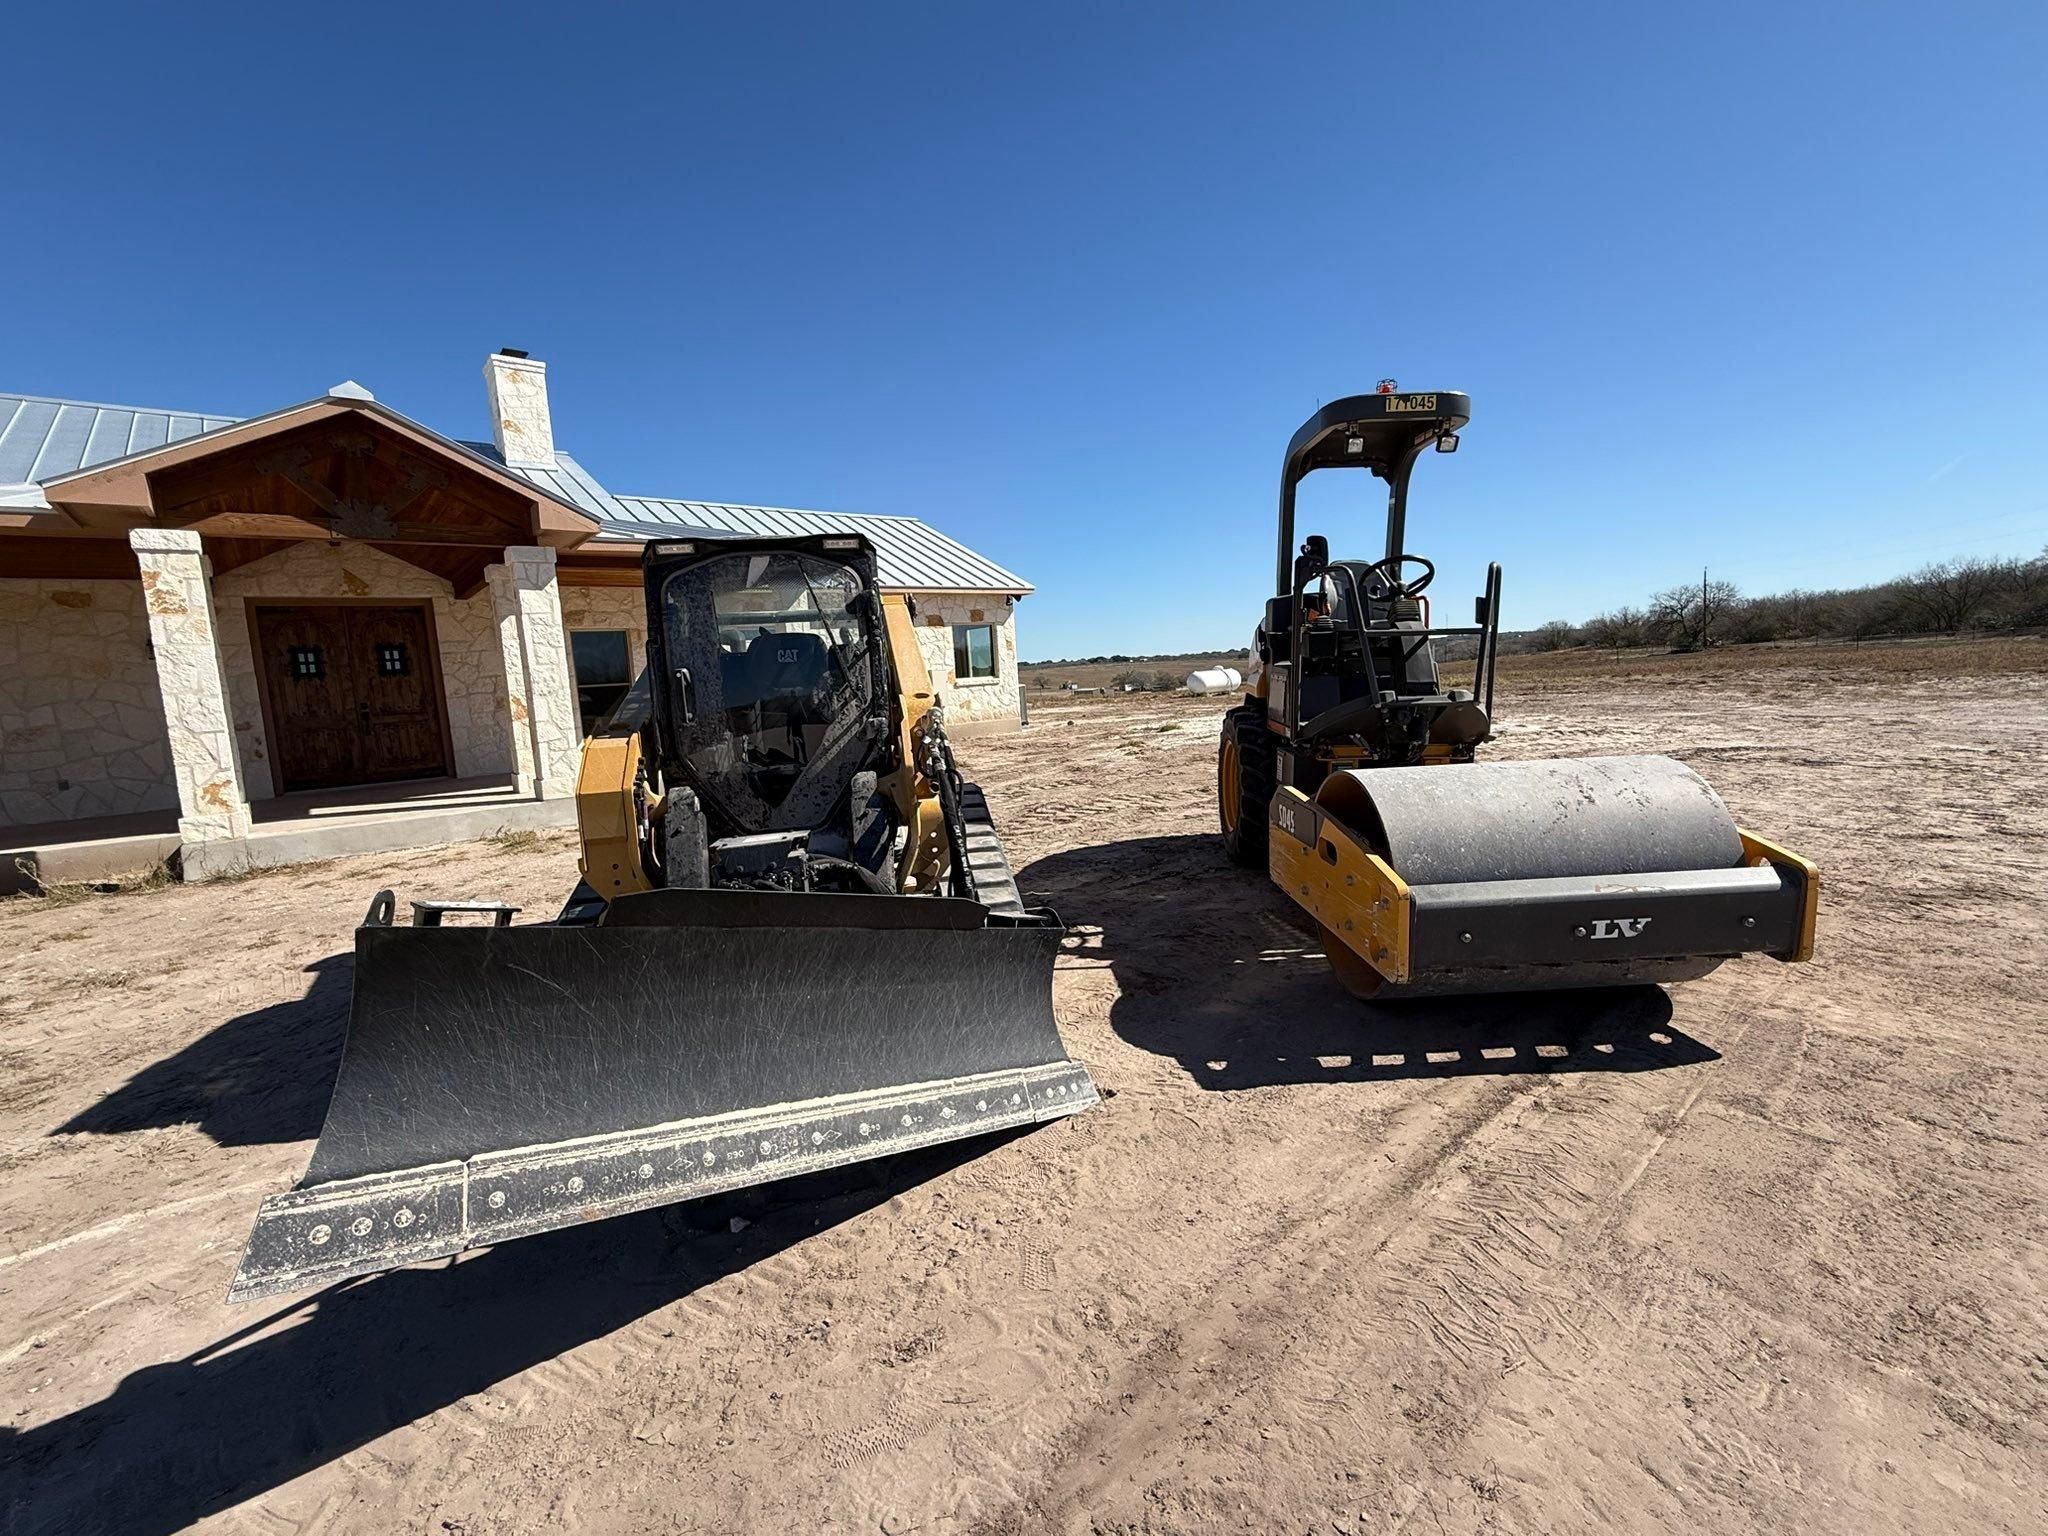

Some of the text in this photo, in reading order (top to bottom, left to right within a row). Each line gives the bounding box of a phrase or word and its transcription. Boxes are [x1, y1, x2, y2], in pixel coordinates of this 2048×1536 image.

[777, 649, 799, 663] CAT
[1278, 804, 1296, 834] SD45
[1590, 917, 1652, 939] LV
